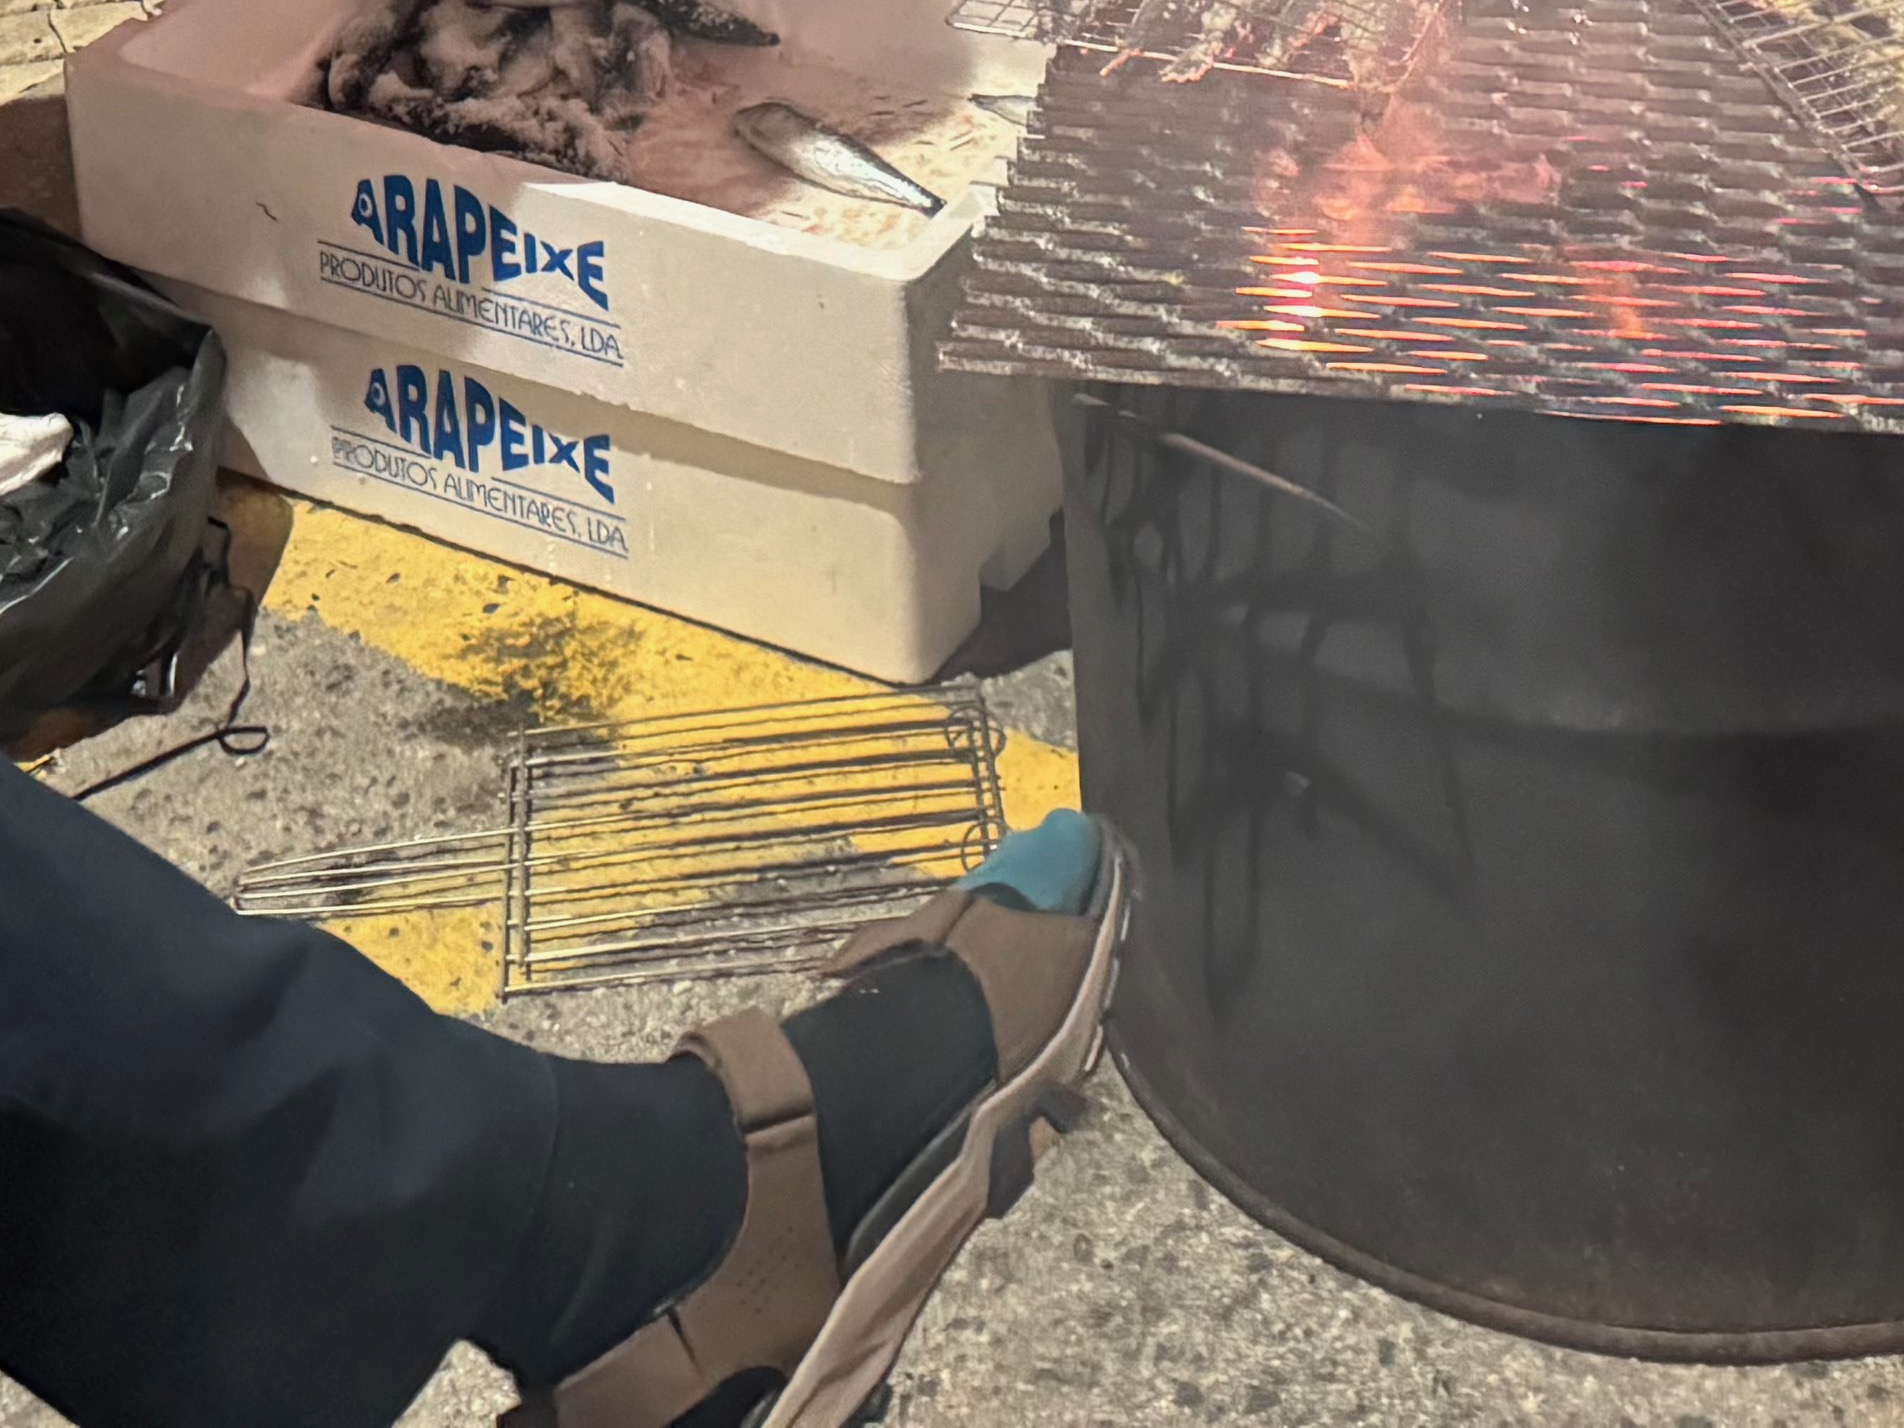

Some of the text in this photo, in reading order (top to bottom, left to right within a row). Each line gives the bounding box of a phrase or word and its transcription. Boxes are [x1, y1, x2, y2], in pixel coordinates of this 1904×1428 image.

[319, 250, 623, 360] PRODUTOS ALIMENTARES, LDA
[351, 175, 609, 312] ARAPEIXE
[331, 436, 630, 552] PRODUTOS ALIMENTARES, LDA
[364, 365, 615, 505] ARAPEIXE
